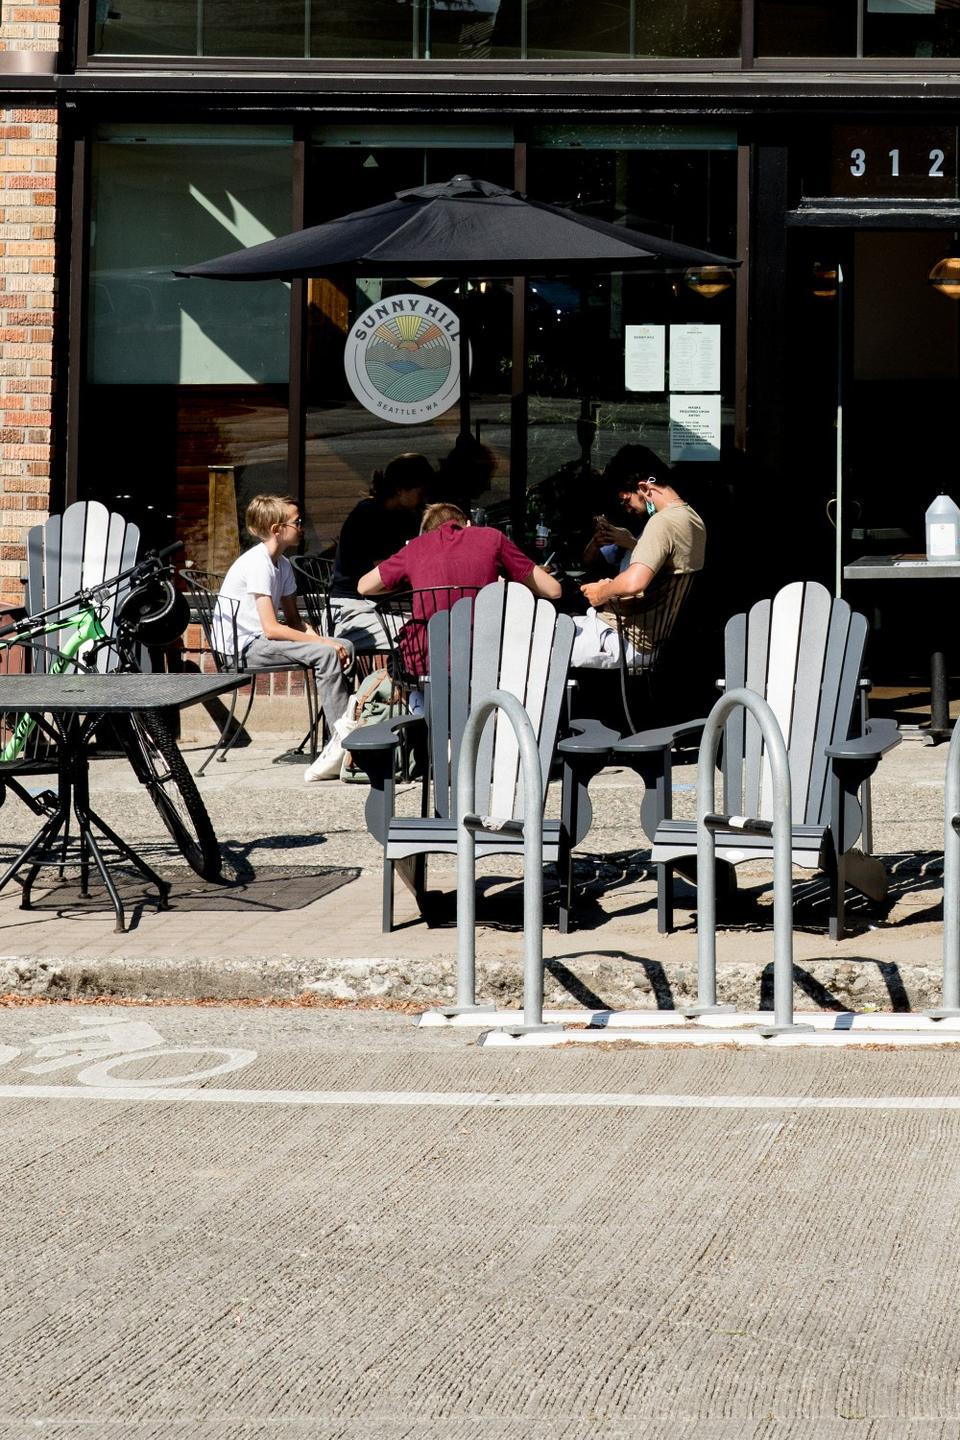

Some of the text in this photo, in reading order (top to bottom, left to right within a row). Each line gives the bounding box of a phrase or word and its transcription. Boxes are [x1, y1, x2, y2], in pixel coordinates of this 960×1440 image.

[355, 299, 460, 342] SUNNY HILL
[376, 401, 438, 415] SEATTLE WA
